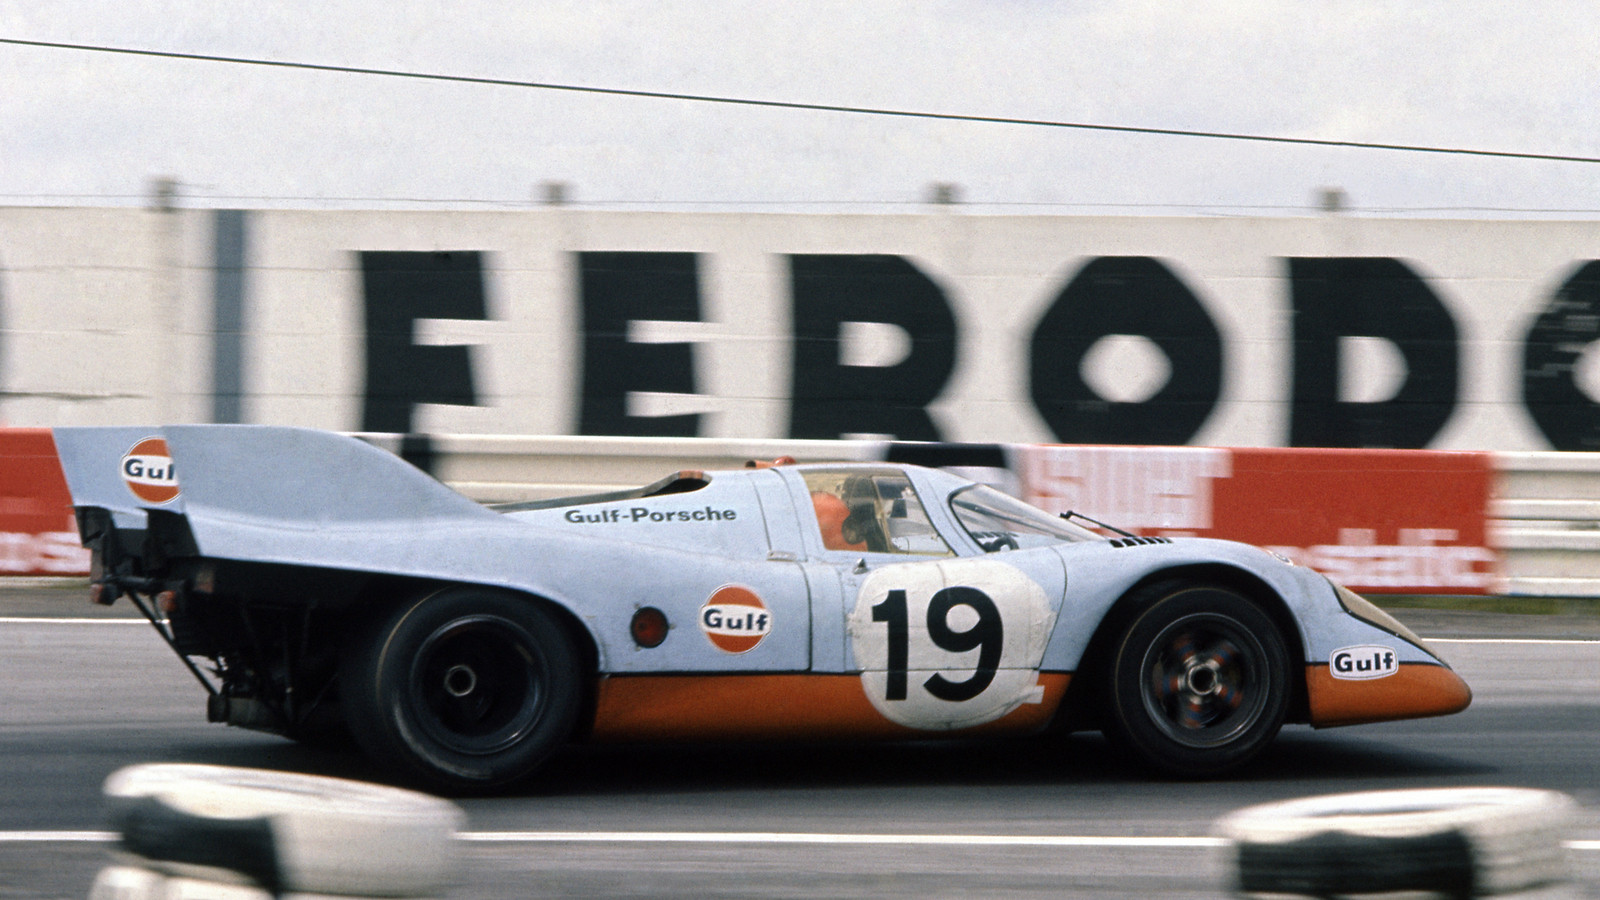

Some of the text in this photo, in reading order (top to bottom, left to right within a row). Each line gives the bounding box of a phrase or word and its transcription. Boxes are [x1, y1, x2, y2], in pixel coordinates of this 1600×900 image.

[124, 458, 176, 481] Gul
[564, 506, 738, 524] Gulf-Porsche
[703, 608, 769, 632] Gulf
[871, 585, 1004, 702] 19
[1334, 652, 1394, 673] Gulf
